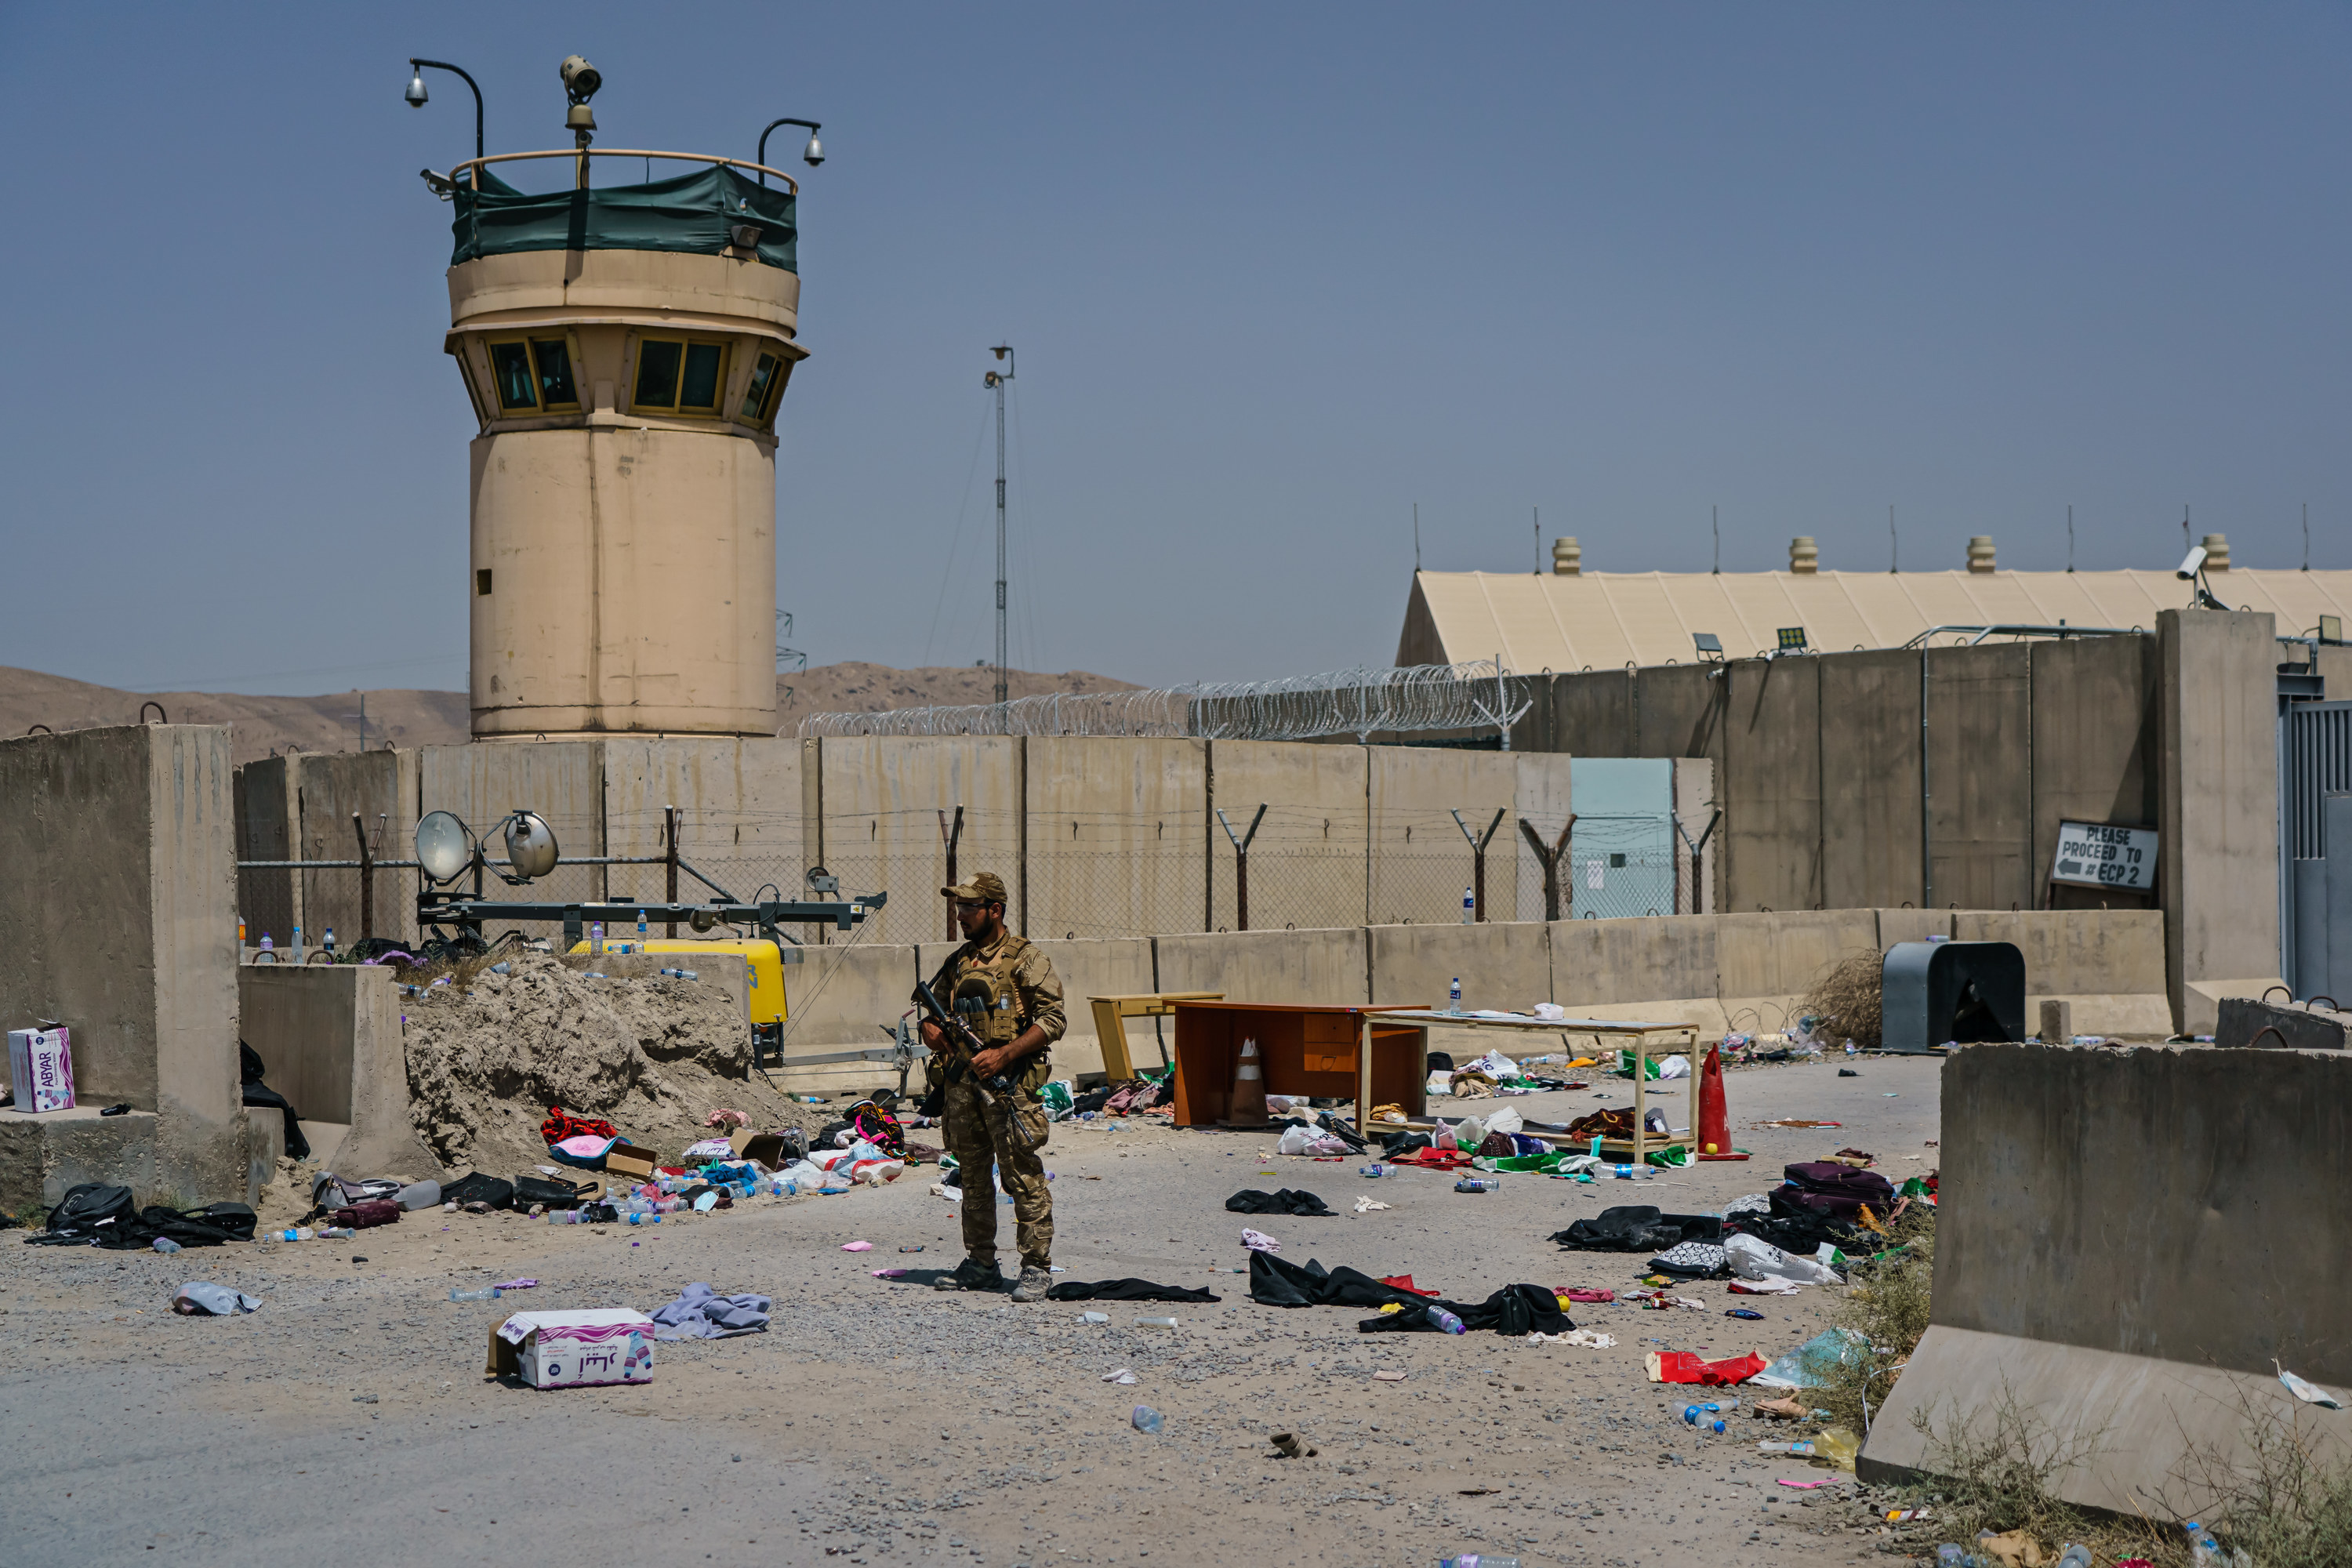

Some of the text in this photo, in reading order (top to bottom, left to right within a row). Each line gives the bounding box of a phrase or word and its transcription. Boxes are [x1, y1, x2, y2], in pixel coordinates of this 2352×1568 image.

[2086, 826, 2130, 845] PLEASE
[2062, 841, 2142, 863] PROCEED TO
[2127, 866, 2140, 884] 2
[39, 1051, 54, 1087] ABYAR
[578, 1352, 618, 1379] أبيار
